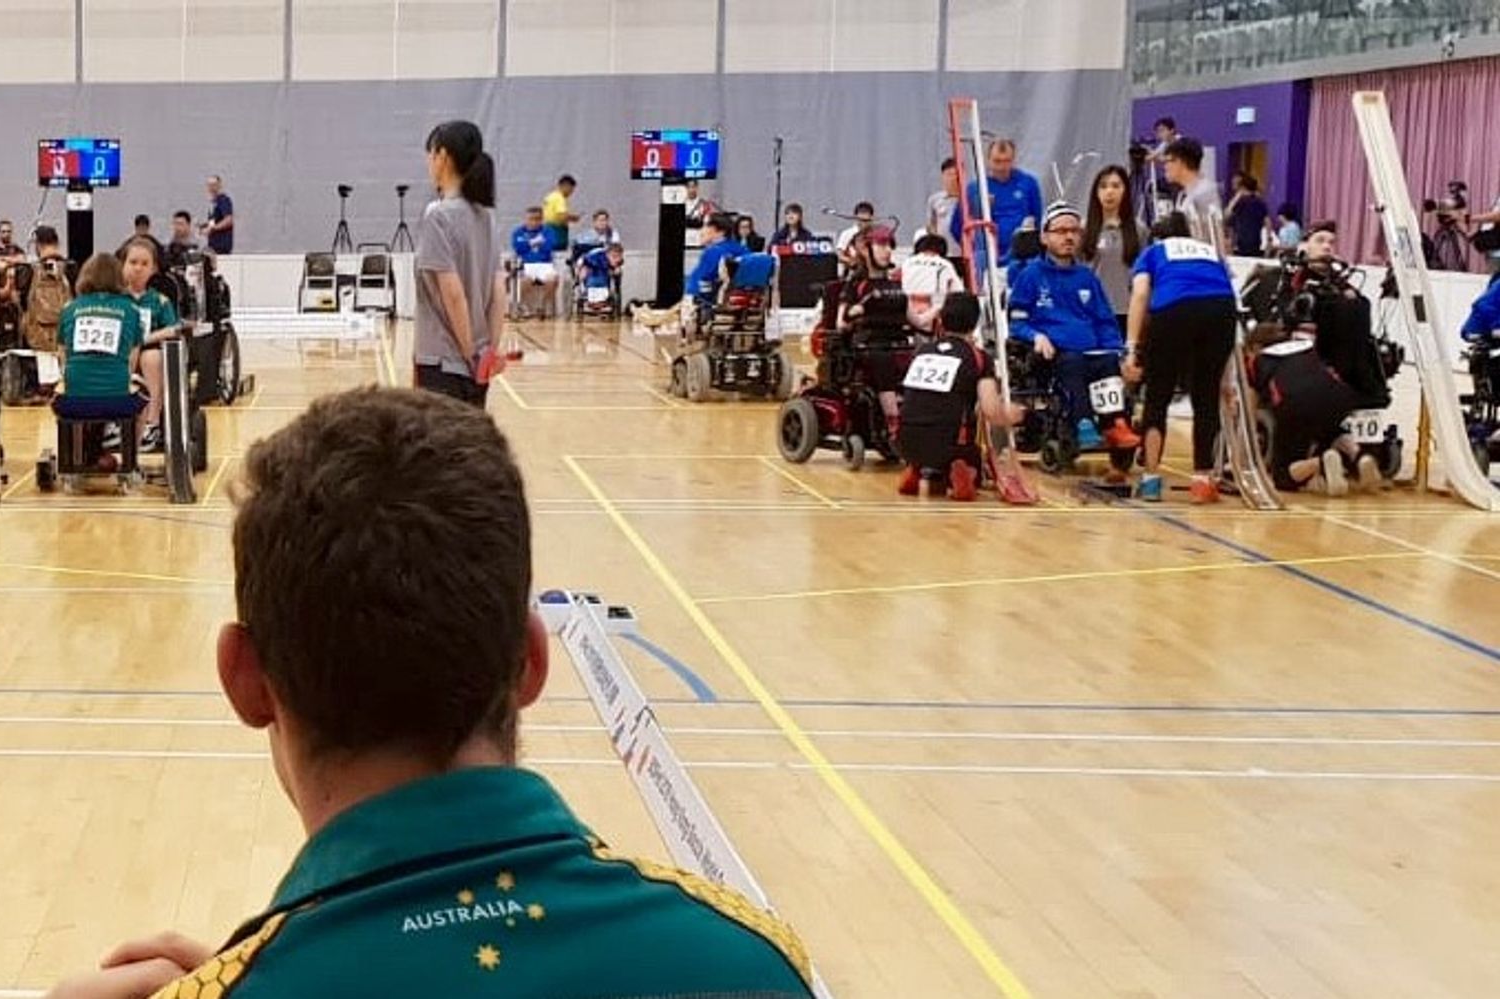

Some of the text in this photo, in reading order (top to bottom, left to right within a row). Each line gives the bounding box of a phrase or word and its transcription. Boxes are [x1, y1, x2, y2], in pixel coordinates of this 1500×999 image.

[53, 155, 106, 176] 0 0
[646, 147, 703, 168] 0 0
[78, 329, 115, 347] 328
[909, 366, 950, 386] 324
[402, 898, 524, 933] AUSTRALIA
